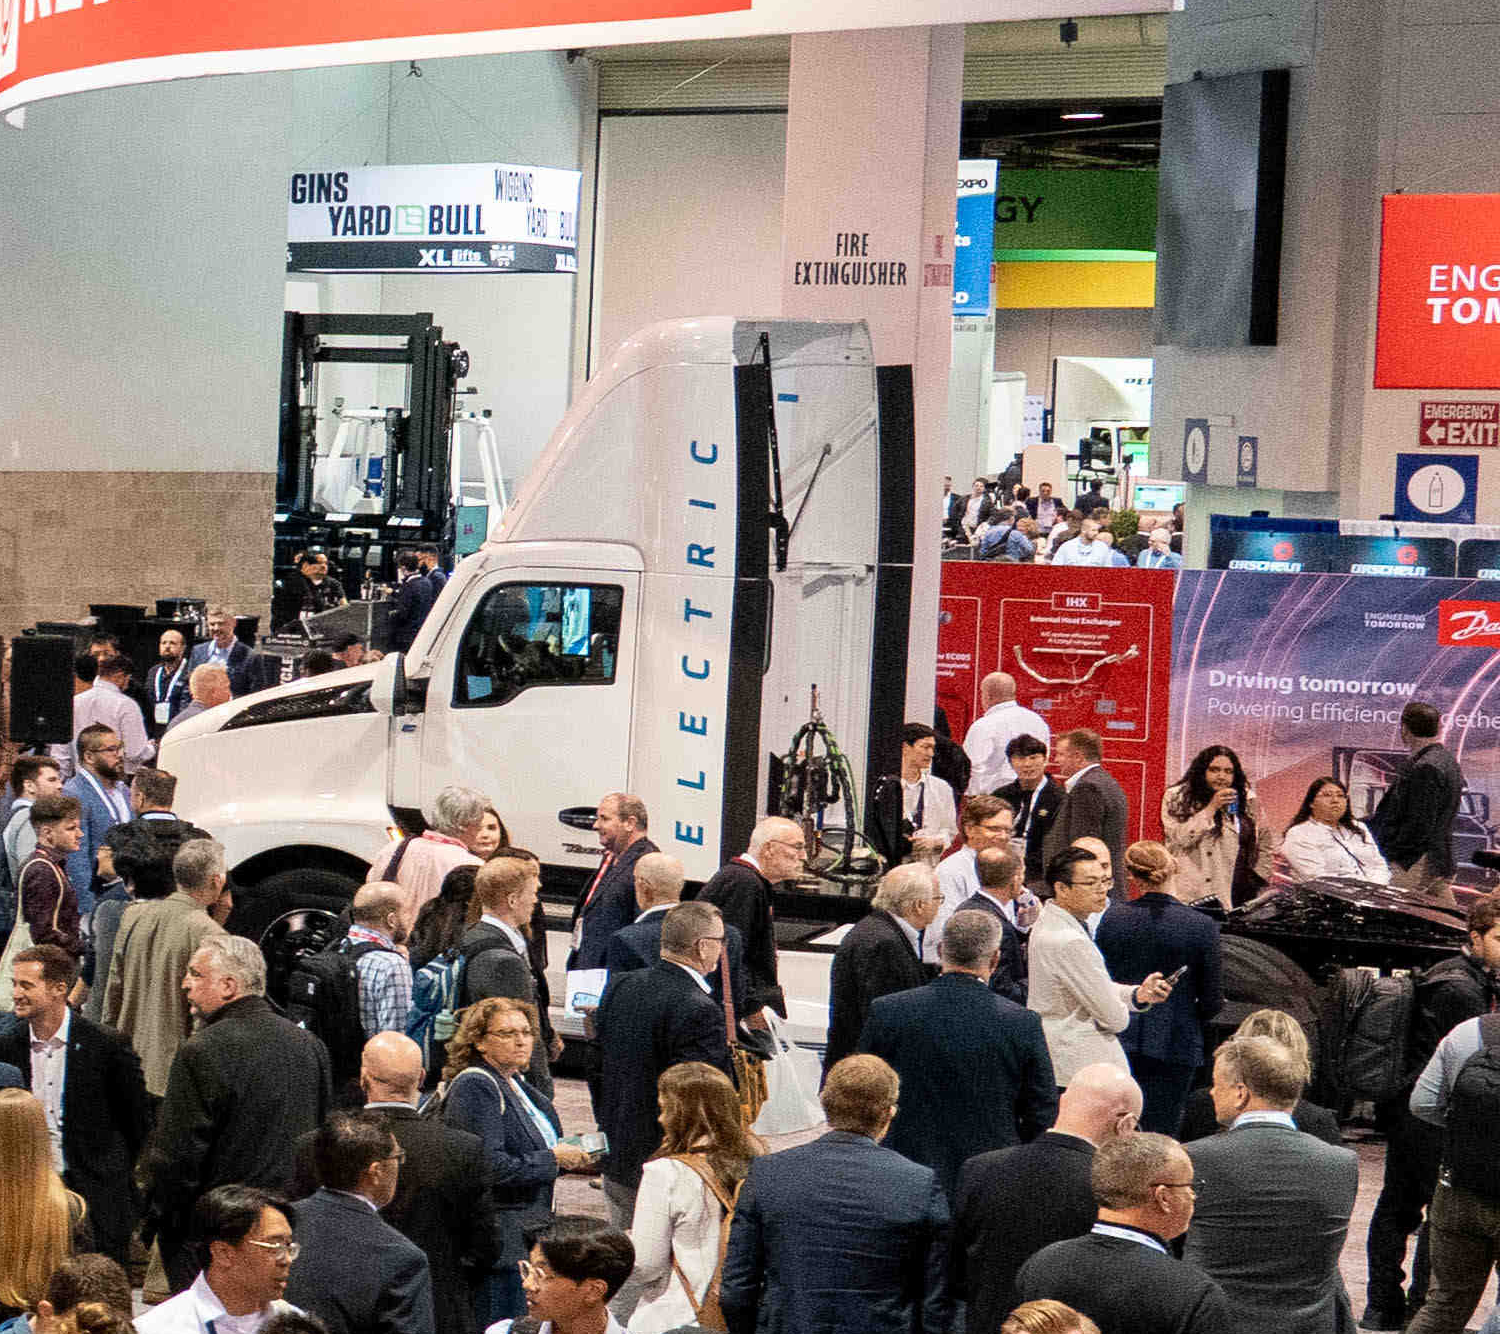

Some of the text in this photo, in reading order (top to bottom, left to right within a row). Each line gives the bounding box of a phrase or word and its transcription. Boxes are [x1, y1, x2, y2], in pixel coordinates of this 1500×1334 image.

[291, 171, 349, 205] GINS
[328, 204, 486, 237] YARD BULL
[995, 196, 1044, 224] GY
[837, 233, 870, 257] FIRE
[795, 262, 908, 285] EXTINGUISHER
[1429, 264, 1500, 293] ENG
[1424, 403, 1496, 420] EMERGENCY
[1446, 422, 1498, 445] EXIT
[1066, 596, 1088, 608] IHX
[1364, 611, 1427, 622] ENGINEERING
[1364, 620, 1426, 630] TOMORROW
[675, 440, 718, 847] ELECTRIC
[1208, 670, 1417, 696] Driving tomorrow
[1206, 697, 1305, 722] Powering
